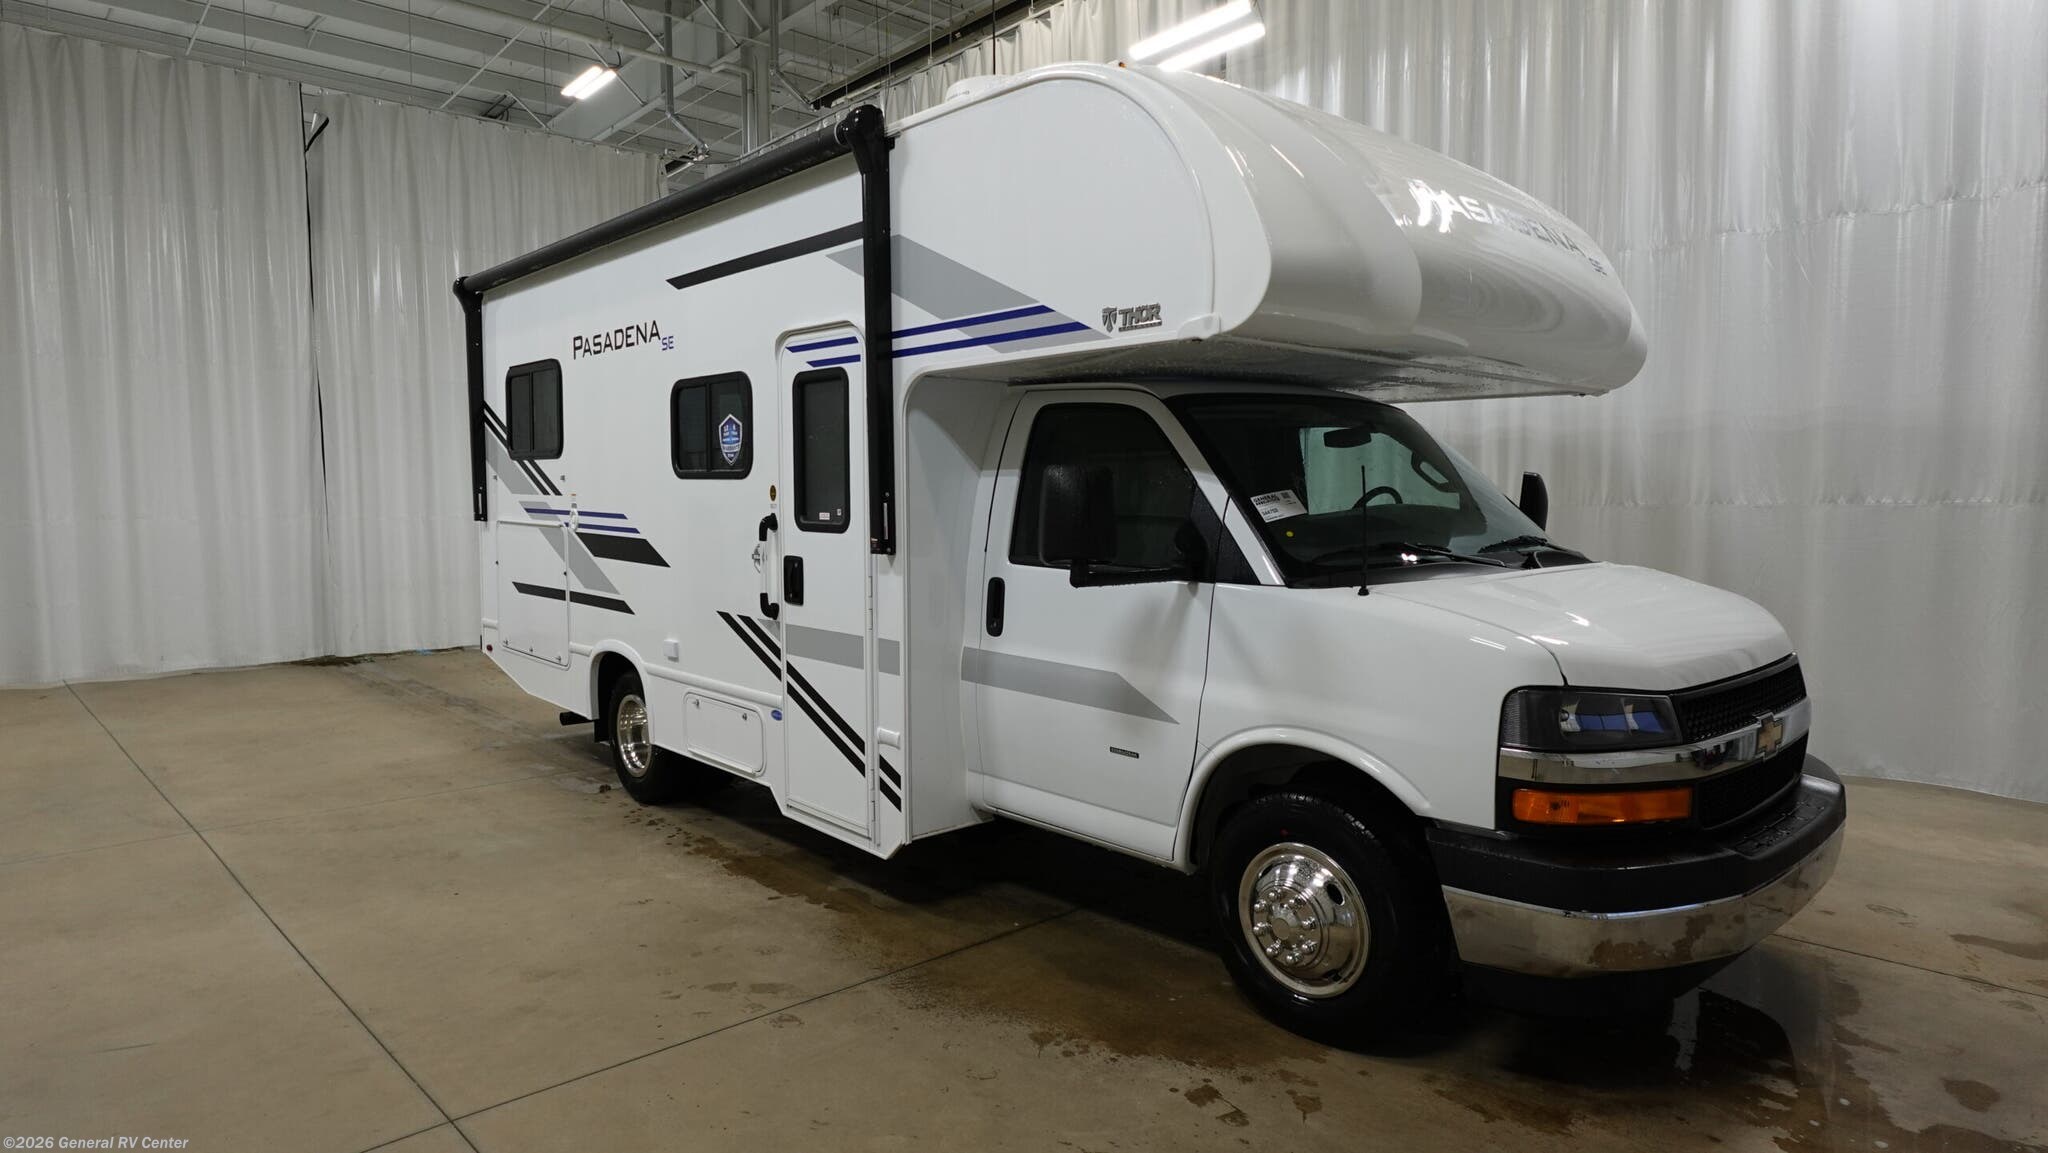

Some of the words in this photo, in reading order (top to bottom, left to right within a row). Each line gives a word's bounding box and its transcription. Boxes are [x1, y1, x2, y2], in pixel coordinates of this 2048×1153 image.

[1119, 302, 1161, 327] THOR
[573, 320, 661, 360] PASADENA
[661, 335, 674, 351] SE
